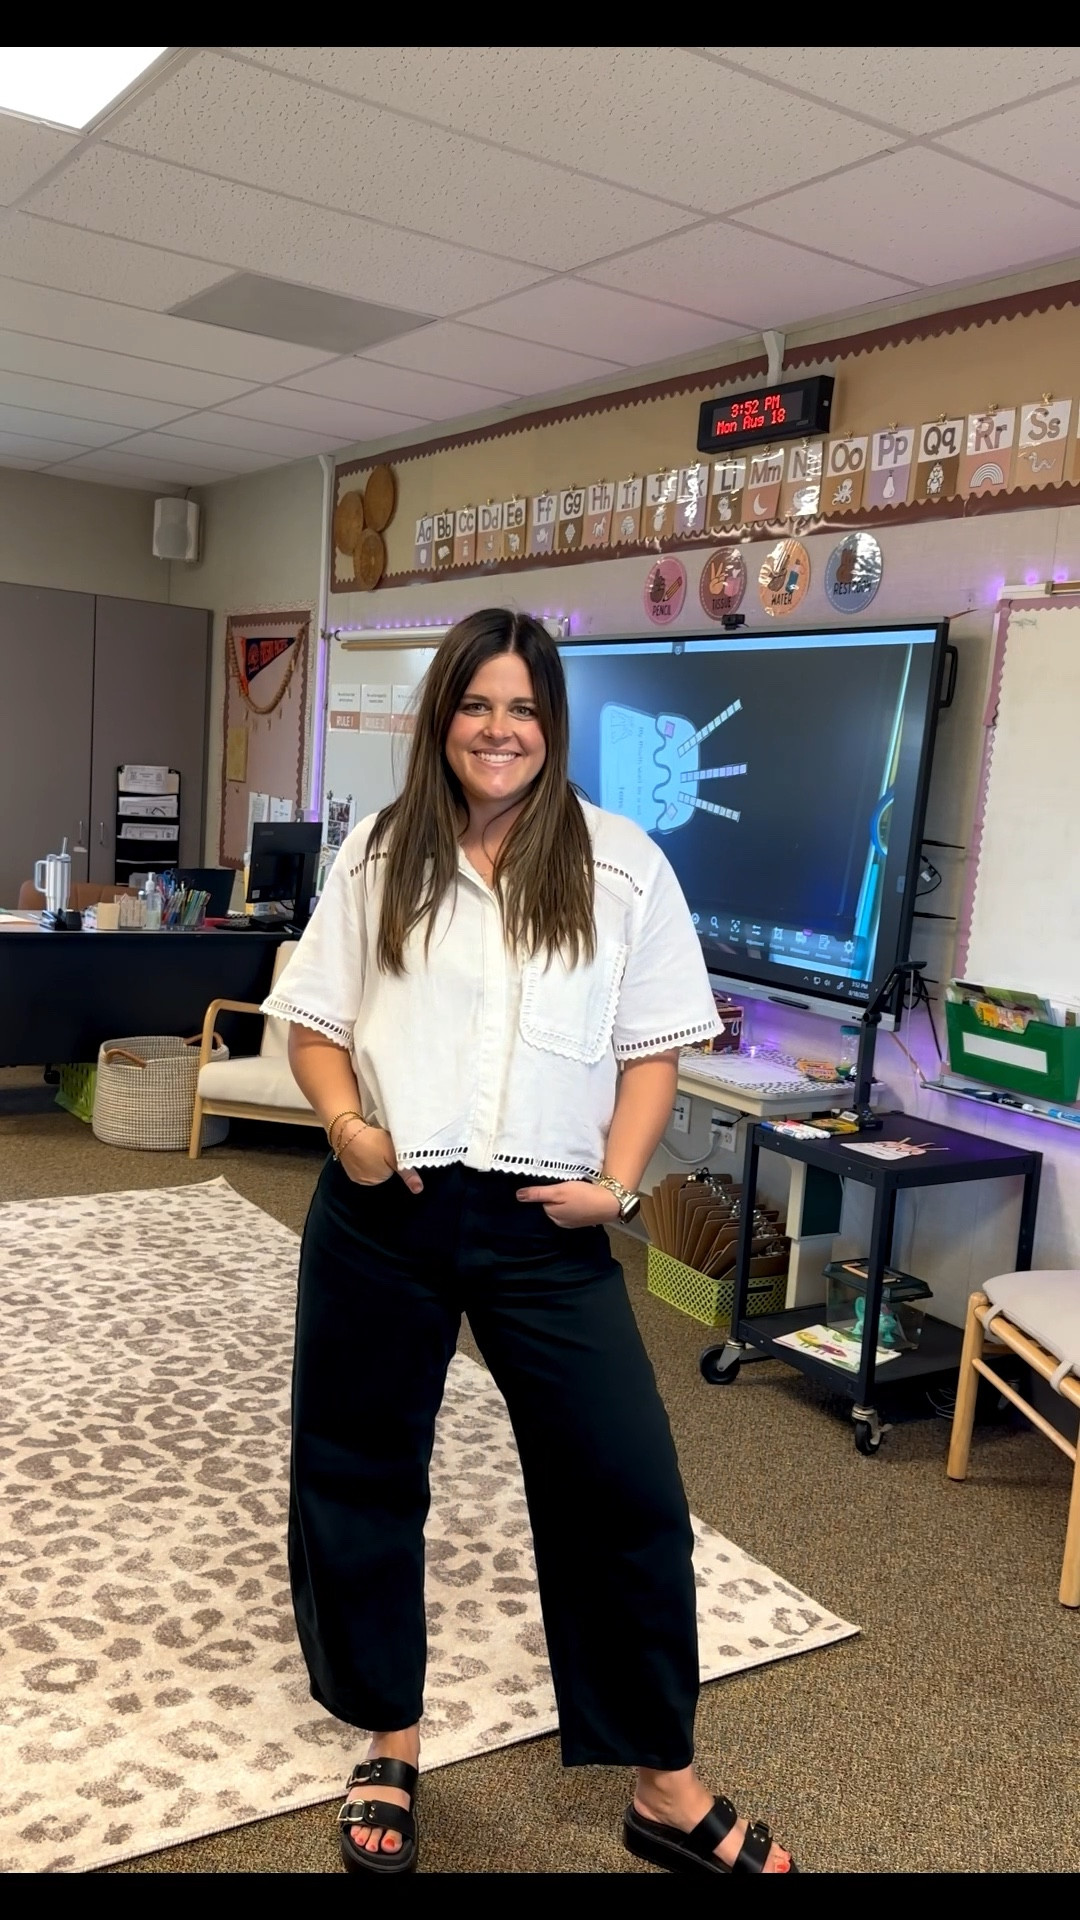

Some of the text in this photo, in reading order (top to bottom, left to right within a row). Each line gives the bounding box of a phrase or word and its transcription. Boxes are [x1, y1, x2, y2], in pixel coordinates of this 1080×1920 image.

[731, 395, 781, 417] 3:52 PM
[716, 408, 786, 435] Mon Aug 18
[1028, 407, 1061, 441] Ss
[923, 426, 956, 456] Qq
[974, 416, 1007, 452] Rr
[831, 443, 864, 473] Oo
[878, 434, 908, 466] Pp
[751, 461, 781, 484] Mm
[592, 485, 610, 511] Hh
[651, 475, 676, 502] J
[507, 503, 523, 527] Ee
[537, 498, 554, 523] Ff
[563, 492, 582, 515] Gg
[417, 520, 432, 542] Aa
[437, 517, 452, 539] Bb
[459, 512, 474, 533] Cc
[482, 508, 499, 530] Dd
[771, 592, 793, 605] WATER
